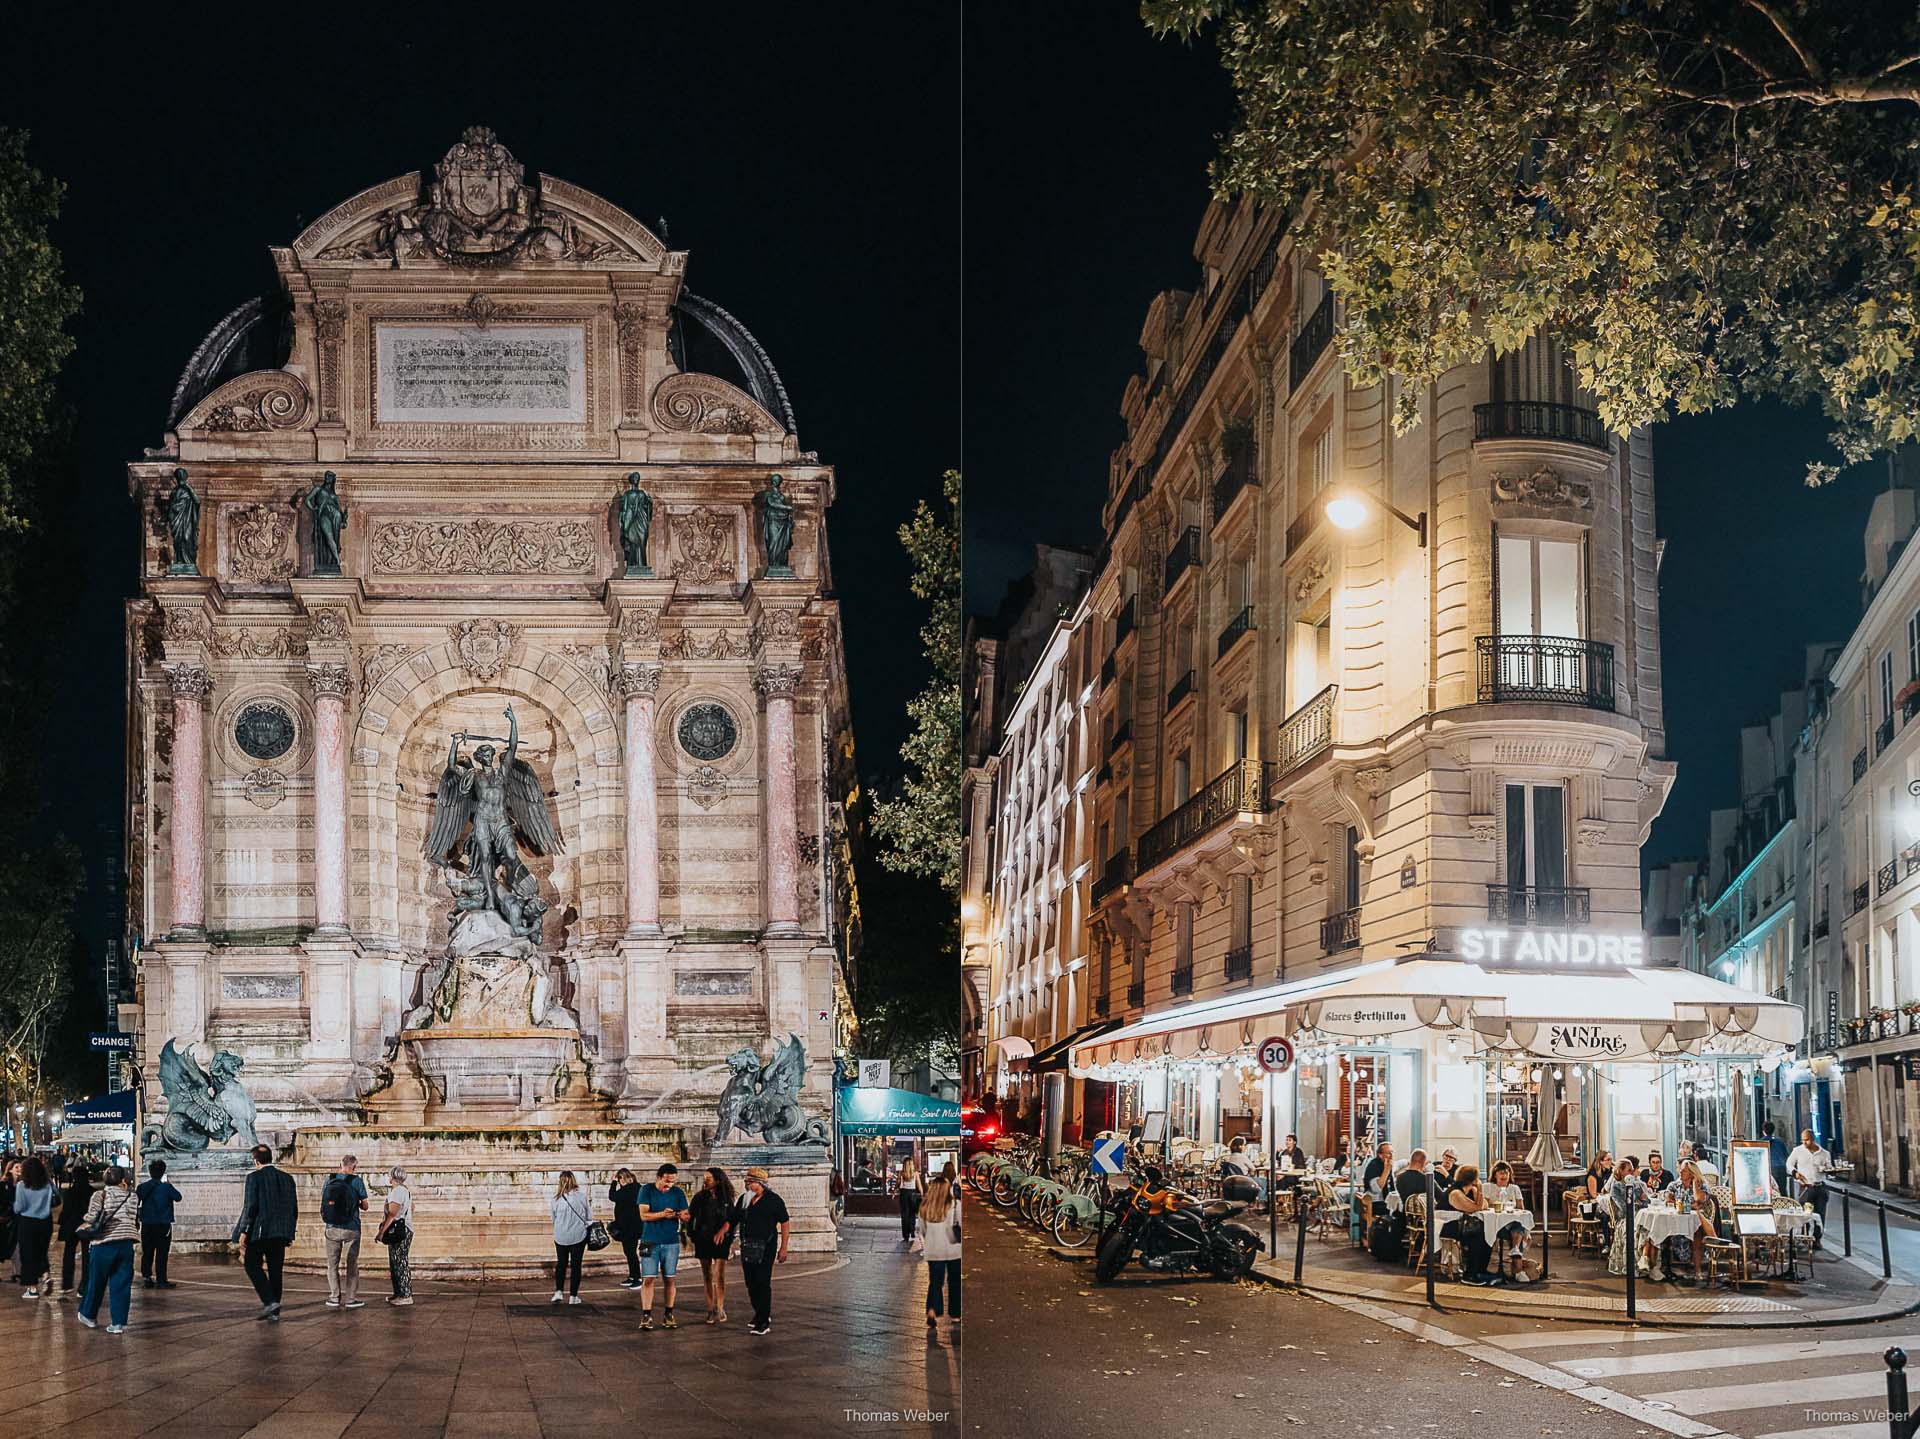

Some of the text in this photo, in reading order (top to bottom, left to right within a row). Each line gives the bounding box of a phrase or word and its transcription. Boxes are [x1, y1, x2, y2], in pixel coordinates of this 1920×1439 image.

[1459, 929, 1644, 966] ST ANDRE
[1325, 1010, 1406, 1024] Glaces Berthillon
[91, 1037, 130, 1047] CHANGE
[1551, 1026, 1602, 1047] SAINT
[1265, 1047, 1287, 1063] 30
